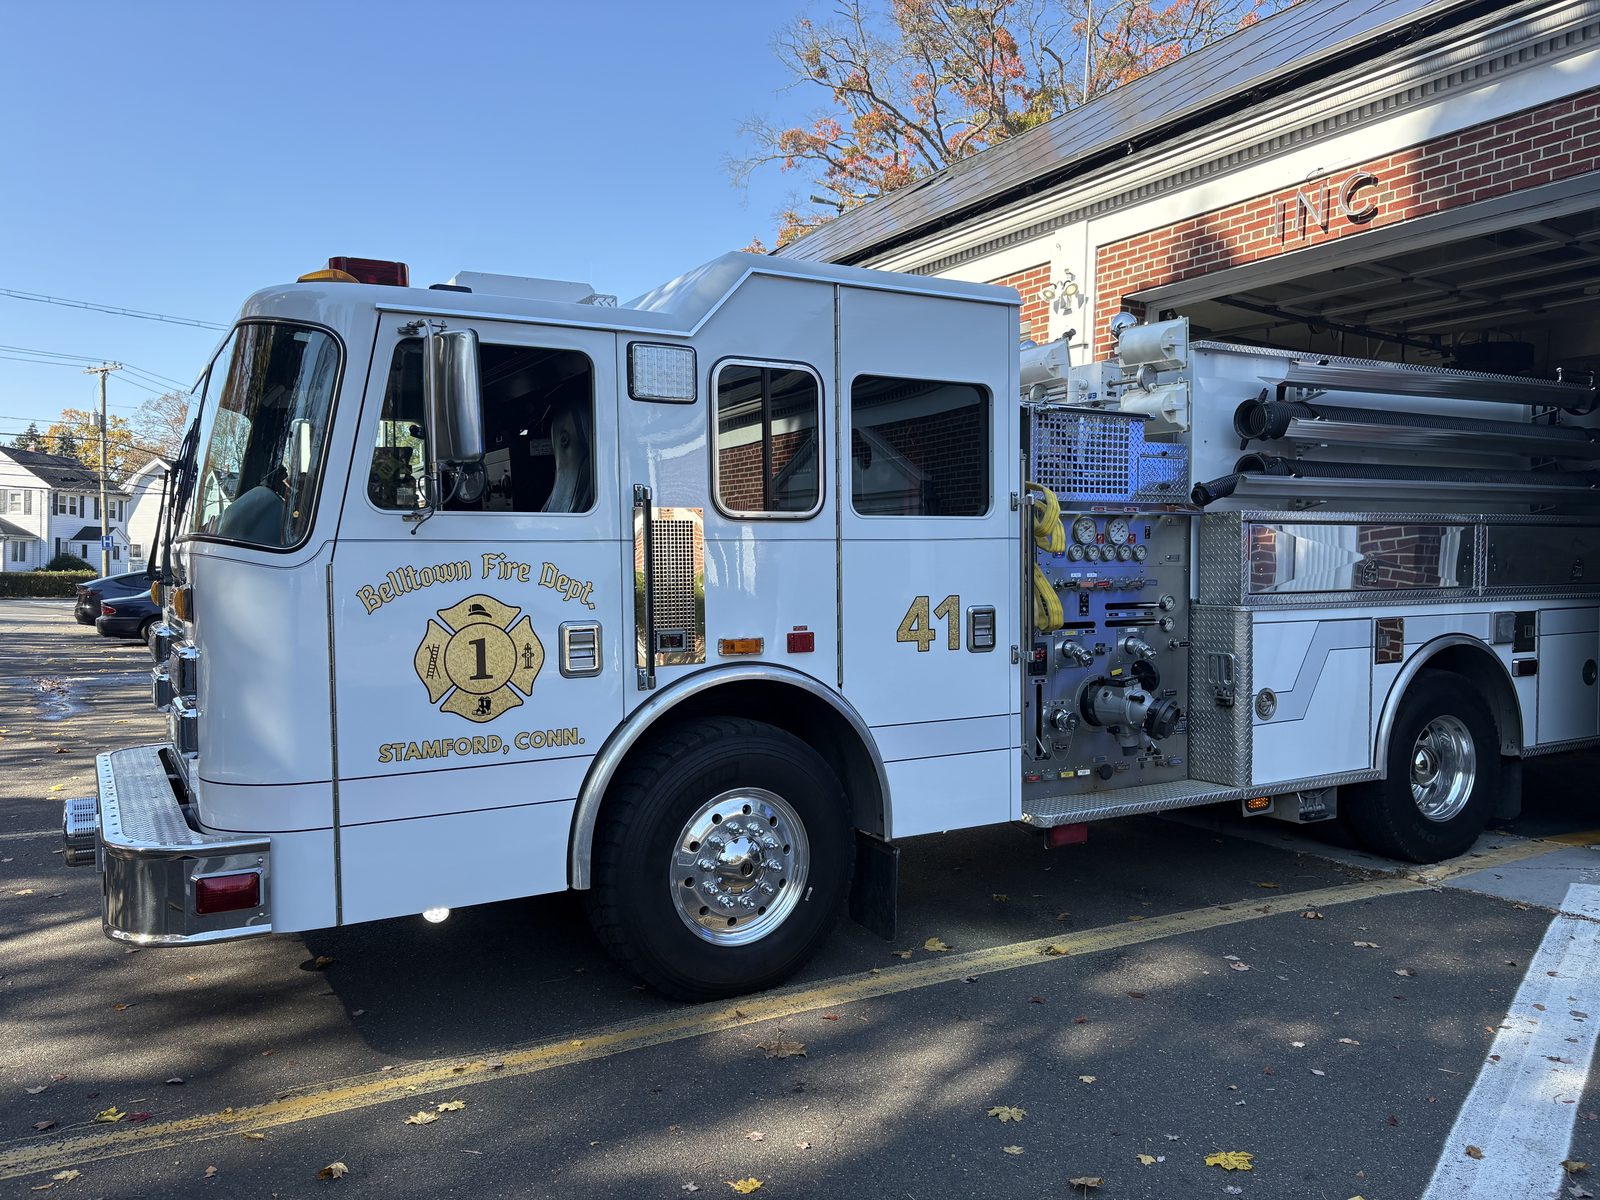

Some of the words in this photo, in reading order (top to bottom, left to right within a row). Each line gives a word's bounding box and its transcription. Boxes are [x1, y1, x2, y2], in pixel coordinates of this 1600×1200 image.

[1273, 171, 1379, 242] INC
[355, 560, 472, 615] Belltown
[481, 552, 531, 583] Fire
[538, 561, 596, 610] Dept.
[896, 594, 960, 652] 41
[468, 637, 494, 681] 1
[378, 734, 510, 763] STAMFORD,
[514, 727, 586, 751] CONN.
